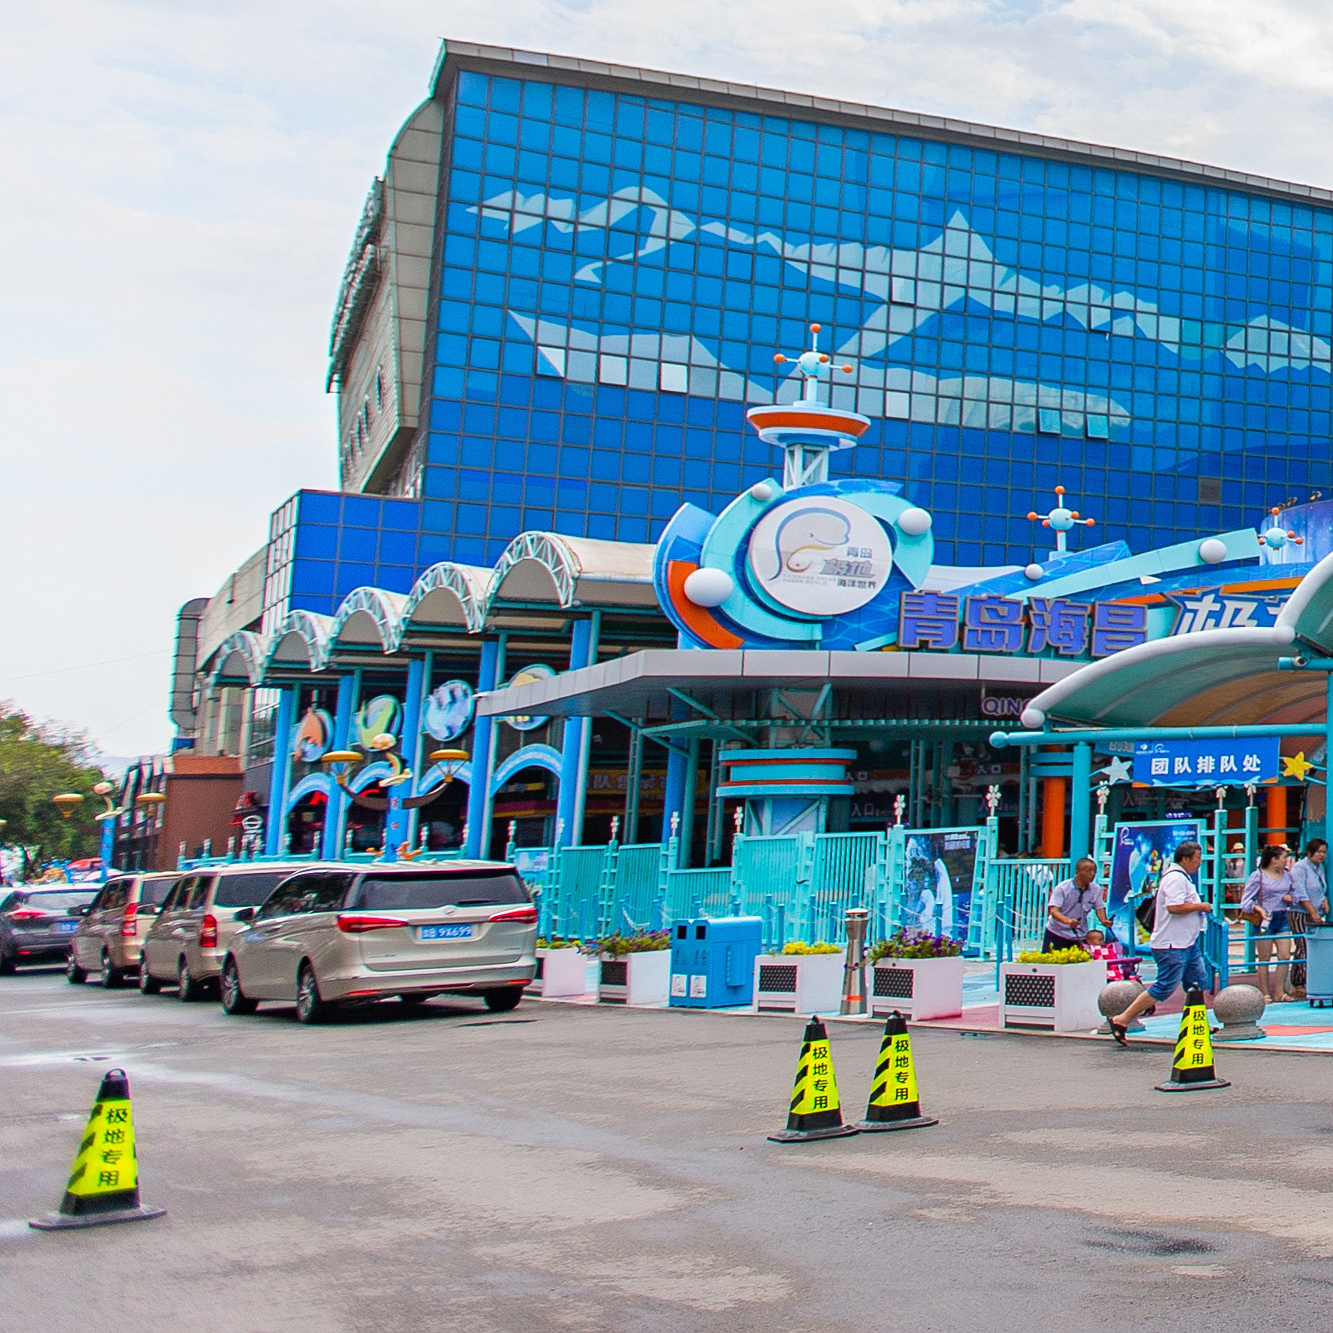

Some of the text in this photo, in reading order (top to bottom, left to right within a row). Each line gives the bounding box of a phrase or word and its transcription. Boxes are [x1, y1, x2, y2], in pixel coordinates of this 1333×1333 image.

[1151, 753, 1262, 776] 团队排队处
[1191, 1010, 1206, 1065] 极地专用
[812, 1046, 829, 1110] 极地专用
[894, 1039, 910, 1101] 极地专用
[97, 1107, 128, 1187] 极地专用
